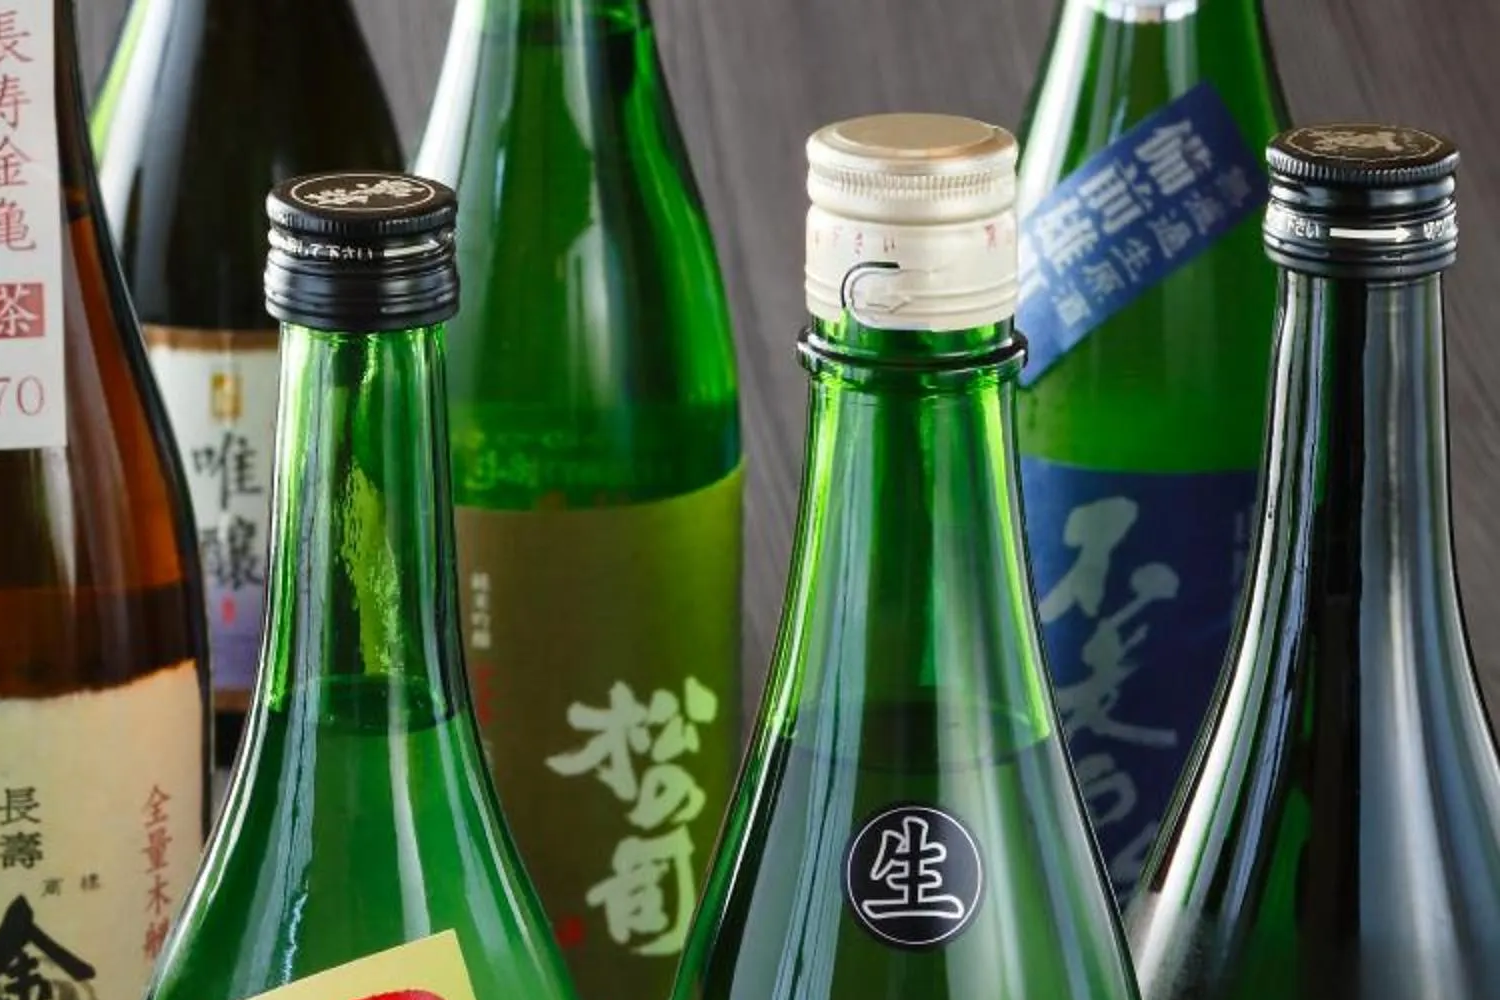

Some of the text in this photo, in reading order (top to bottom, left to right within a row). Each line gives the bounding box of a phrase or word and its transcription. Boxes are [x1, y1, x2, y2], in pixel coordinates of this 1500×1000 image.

[544, 676, 718, 957] 松の司
[861, 815, 965, 920] 生
